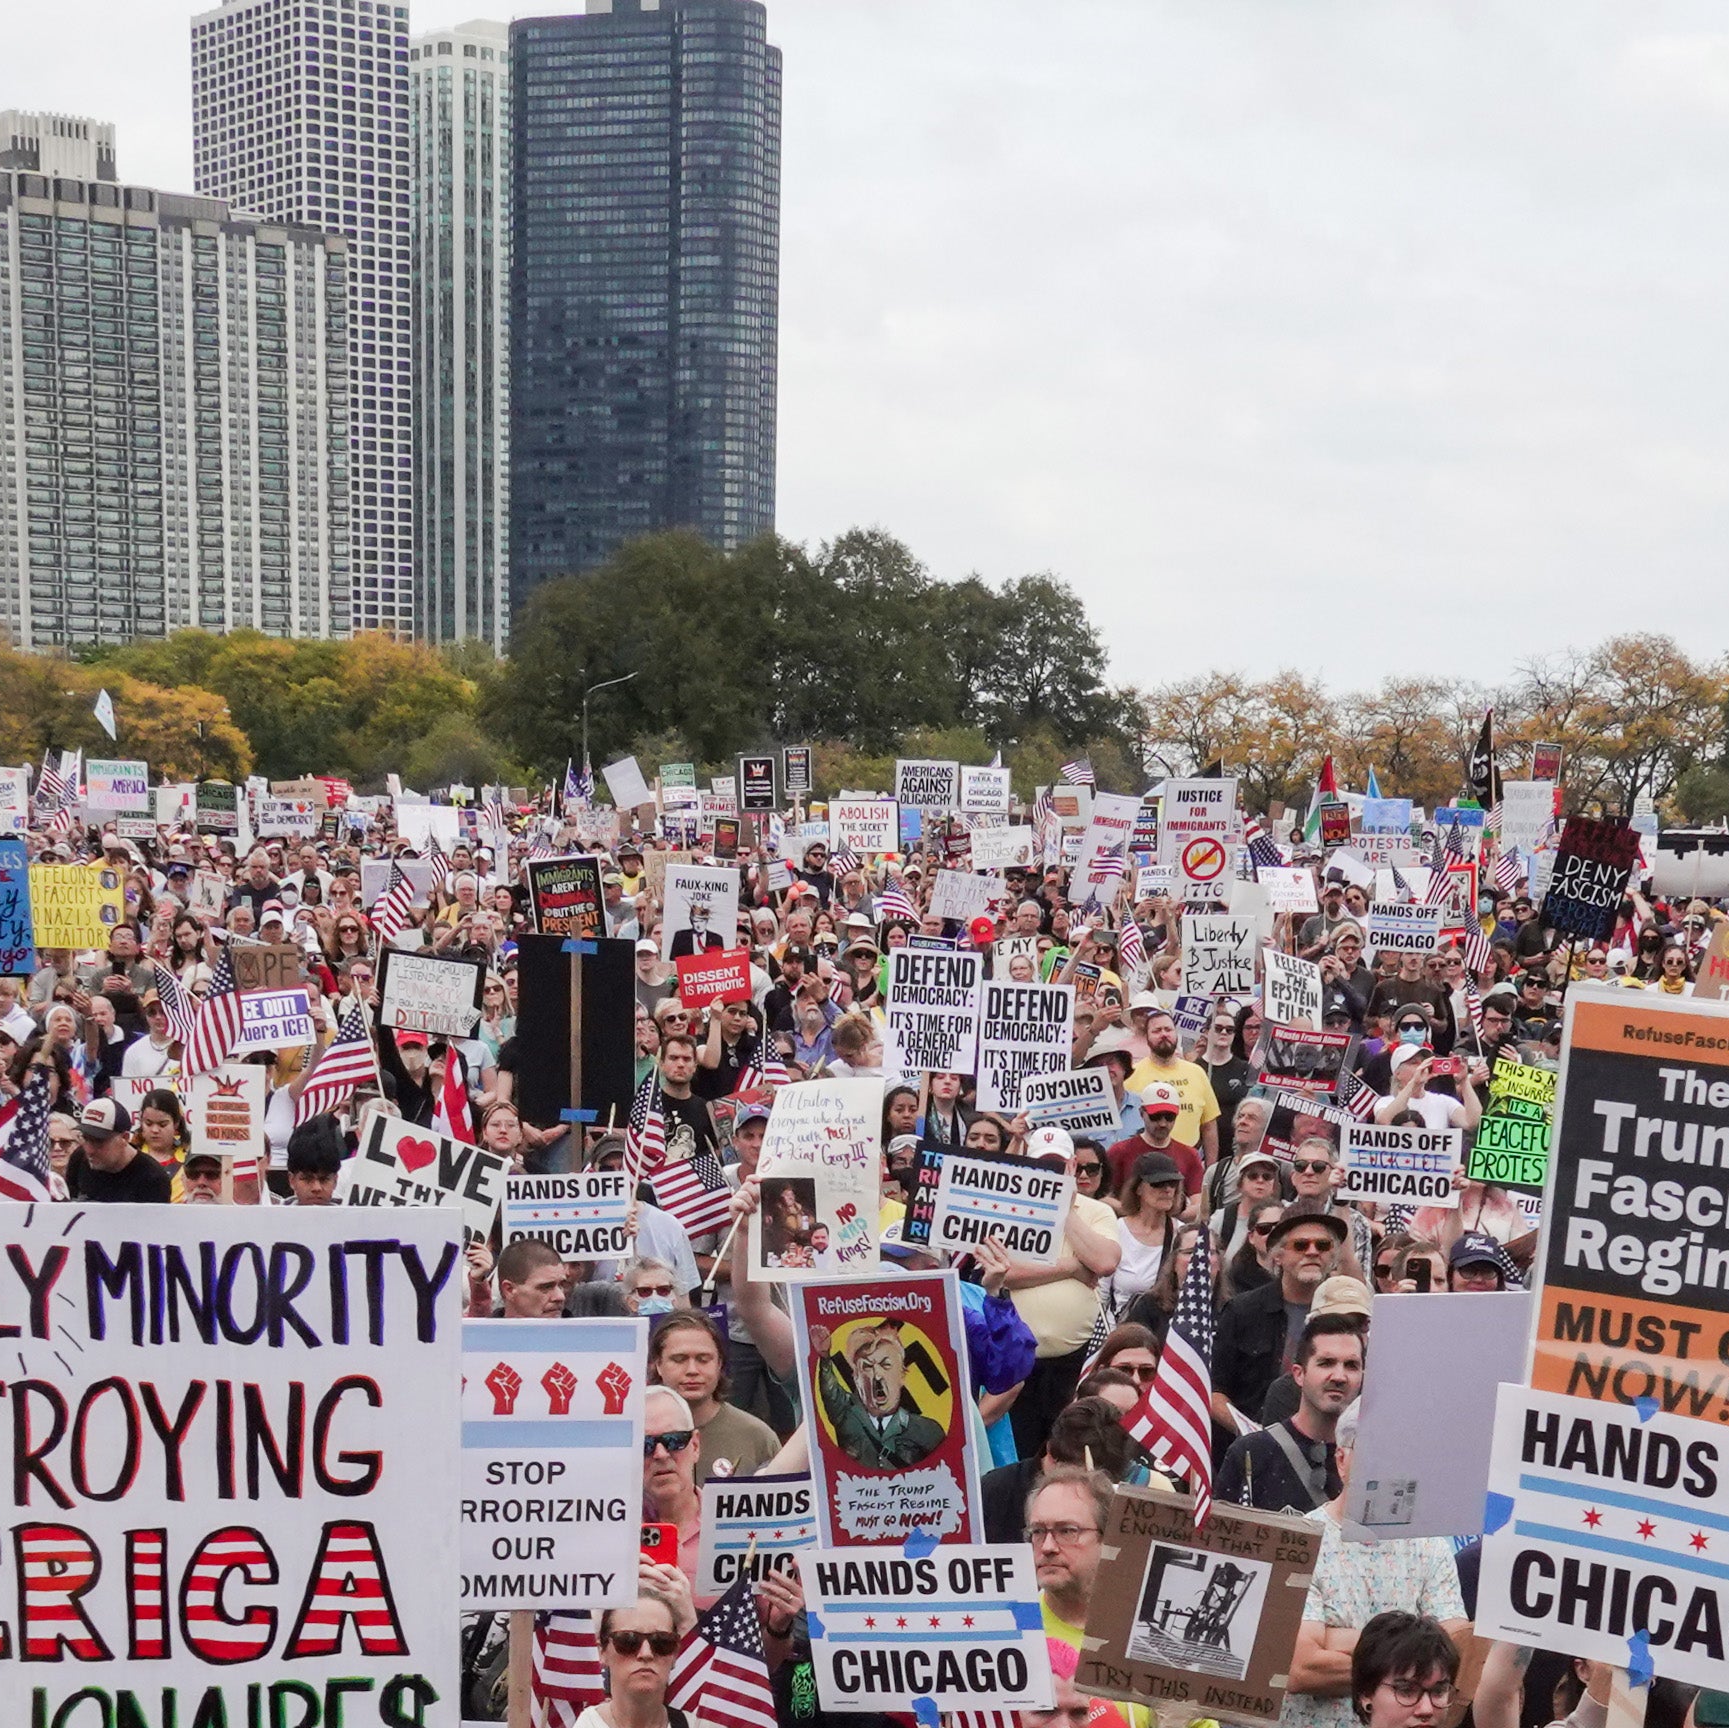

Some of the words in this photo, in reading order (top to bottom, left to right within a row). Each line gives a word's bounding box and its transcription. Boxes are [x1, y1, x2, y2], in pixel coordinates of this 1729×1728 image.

[901, 766, 953, 780] AMERICANS
[901, 778, 953, 793] AGAINST
[1177, 789, 1223, 803] JUSTICE
[838, 806, 889, 820] ABOLISH
[1189, 806, 1207, 818] FOR
[1166, 820, 1227, 832] IMMIGRANTS
[848, 834, 883, 849] POLICE
[43, 867, 95, 885] FELONS
[1565, 854, 1629, 888] DENY
[44, 886, 103, 904] FASCISTS
[675, 878, 729, 893] FAUX-KING
[1182, 881, 1224, 899] 1776
[44, 908, 91, 926] NAZIS
[1371, 903, 1413, 918] HANDS
[1416, 906, 1439, 919] OFF
[1192, 919, 1248, 948] Liberty
[1369, 931, 1436, 949] CHICAGO
[895, 953, 976, 988] DEFEND
[1202, 950, 1253, 972] Justice
[682, 966, 741, 986] DISSENT
[695, 977, 747, 995] PATRIOTIC
[1212, 972, 1251, 992] ALL
[892, 985, 974, 1008] DEMOCRACY:
[987, 987, 1068, 1023] DEFEND
[890, 1012, 913, 1029] IT'S
[916, 1013, 945, 1032] TIME
[947, 1015, 972, 1034] FOR
[984, 1021, 1067, 1044] DEMOCRACY:
[907, 1031, 962, 1051] GENERAL
[904, 1048, 952, 1069] STRIKE!
[984, 1049, 1007, 1069] IT'S
[1009, 1050, 1039, 1070] TIME
[1042, 1052, 1066, 1071] FOR
[1349, 1129, 1410, 1149] HANDS
[1420, 1133, 1453, 1151] OFF
[506, 1178, 581, 1200] HANDS
[586, 1176, 625, 1198] OFF
[951, 1164, 1023, 1196] HANDS
[1027, 1176, 1064, 1200] OFF
[1346, 1170, 1450, 1198] CHICAGO
[942, 1214, 1052, 1255] CHICAGO
[83, 1237, 458, 1352] MINORITY
[817, 1292, 932, 1315] RefuseFascism.Org
[1553, 1301, 1701, 1360] MUST
[1520, 1408, 1720, 1502] HANDS
[485, 1462, 567, 1488] STOP
[888, 1484, 935, 1497] TRUMP
[716, 1490, 810, 1518] HANDS
[1123, 1500, 1156, 1519] NO
[1119, 1517, 1192, 1541] ENOUGH
[1218, 1535, 1264, 1554] THAT
[492, 1537, 556, 1561] OUR
[815, 1558, 943, 1596] HANDS
[948, 1556, 1015, 1592] OFF
[831, 1646, 1030, 1696] CHICAGO
